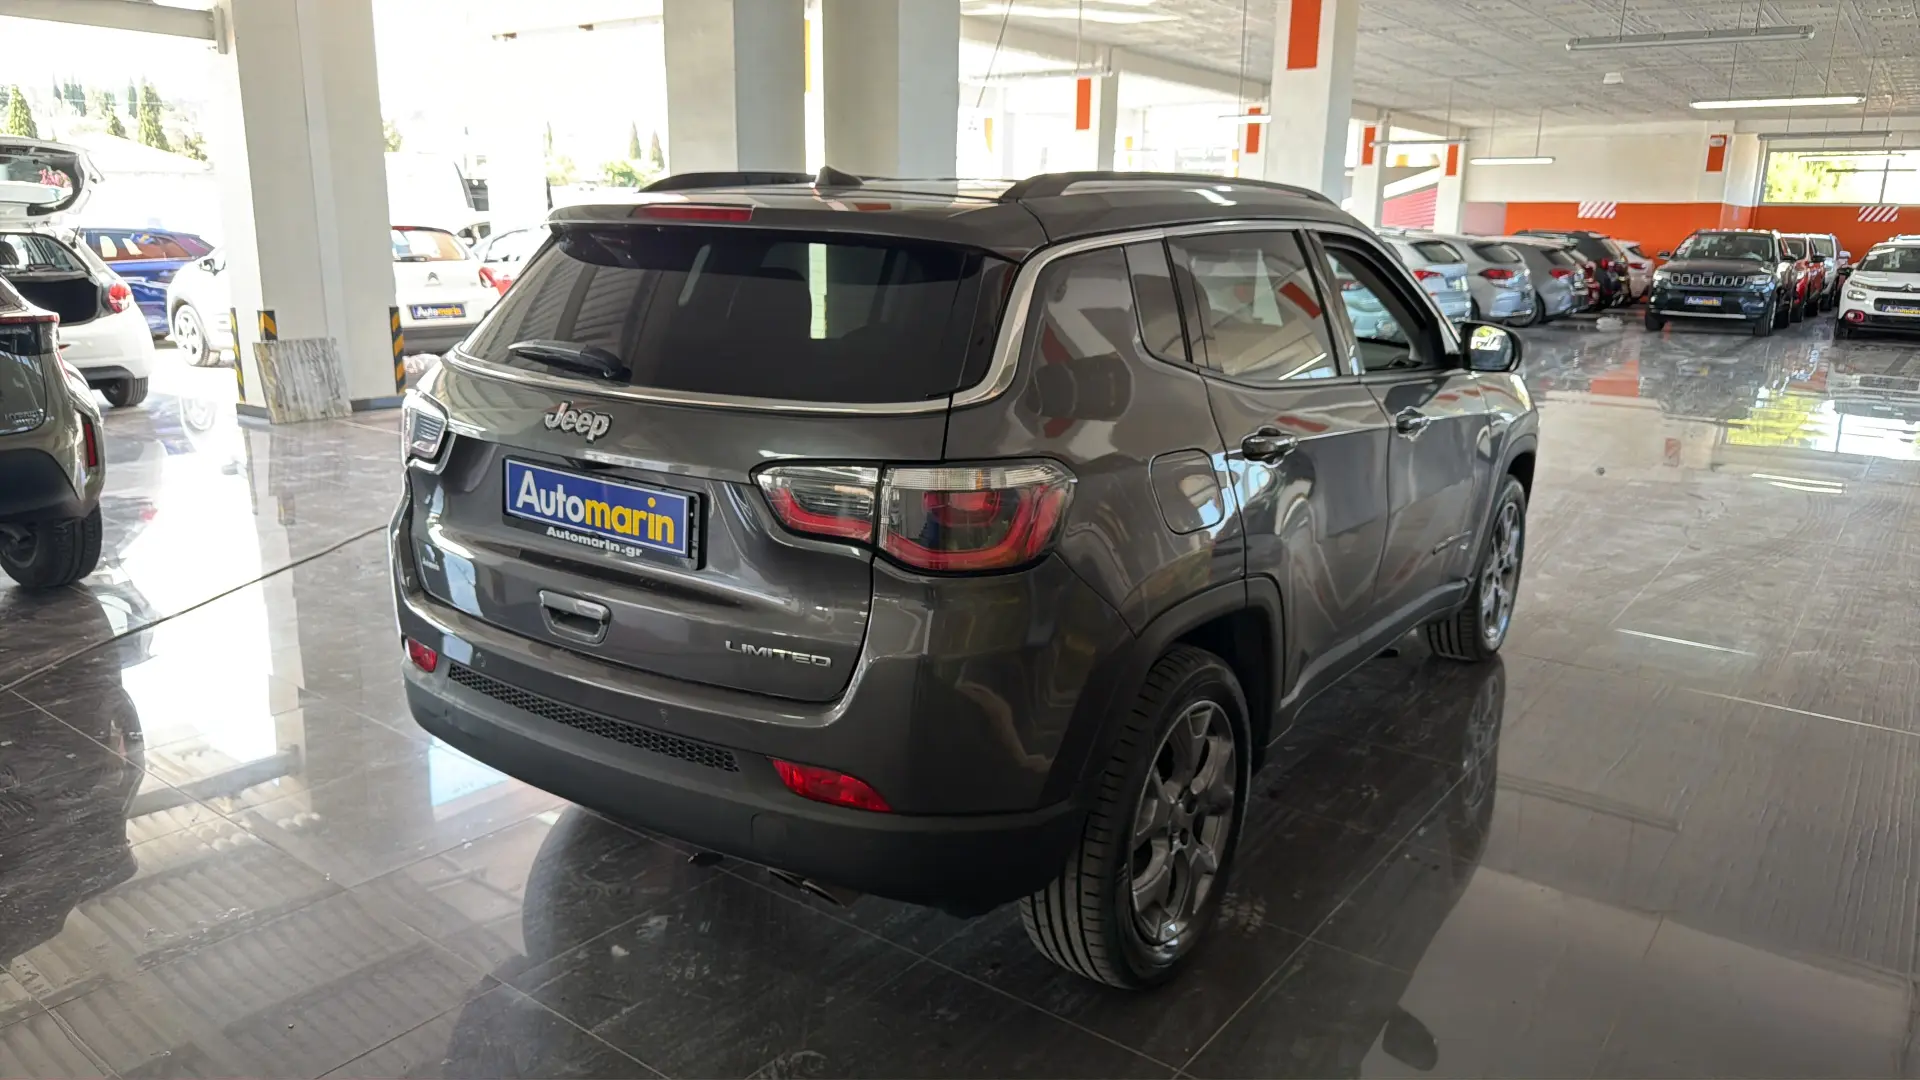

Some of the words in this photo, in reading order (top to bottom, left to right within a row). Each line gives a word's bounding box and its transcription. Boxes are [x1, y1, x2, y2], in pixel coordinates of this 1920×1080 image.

[417, 305, 462, 317] Automarin
[544, 402, 613, 443] Jeep
[516, 470, 675, 545] Automarin
[546, 528, 643, 558] Automarin.gr
[725, 640, 832, 668] LIMITED
